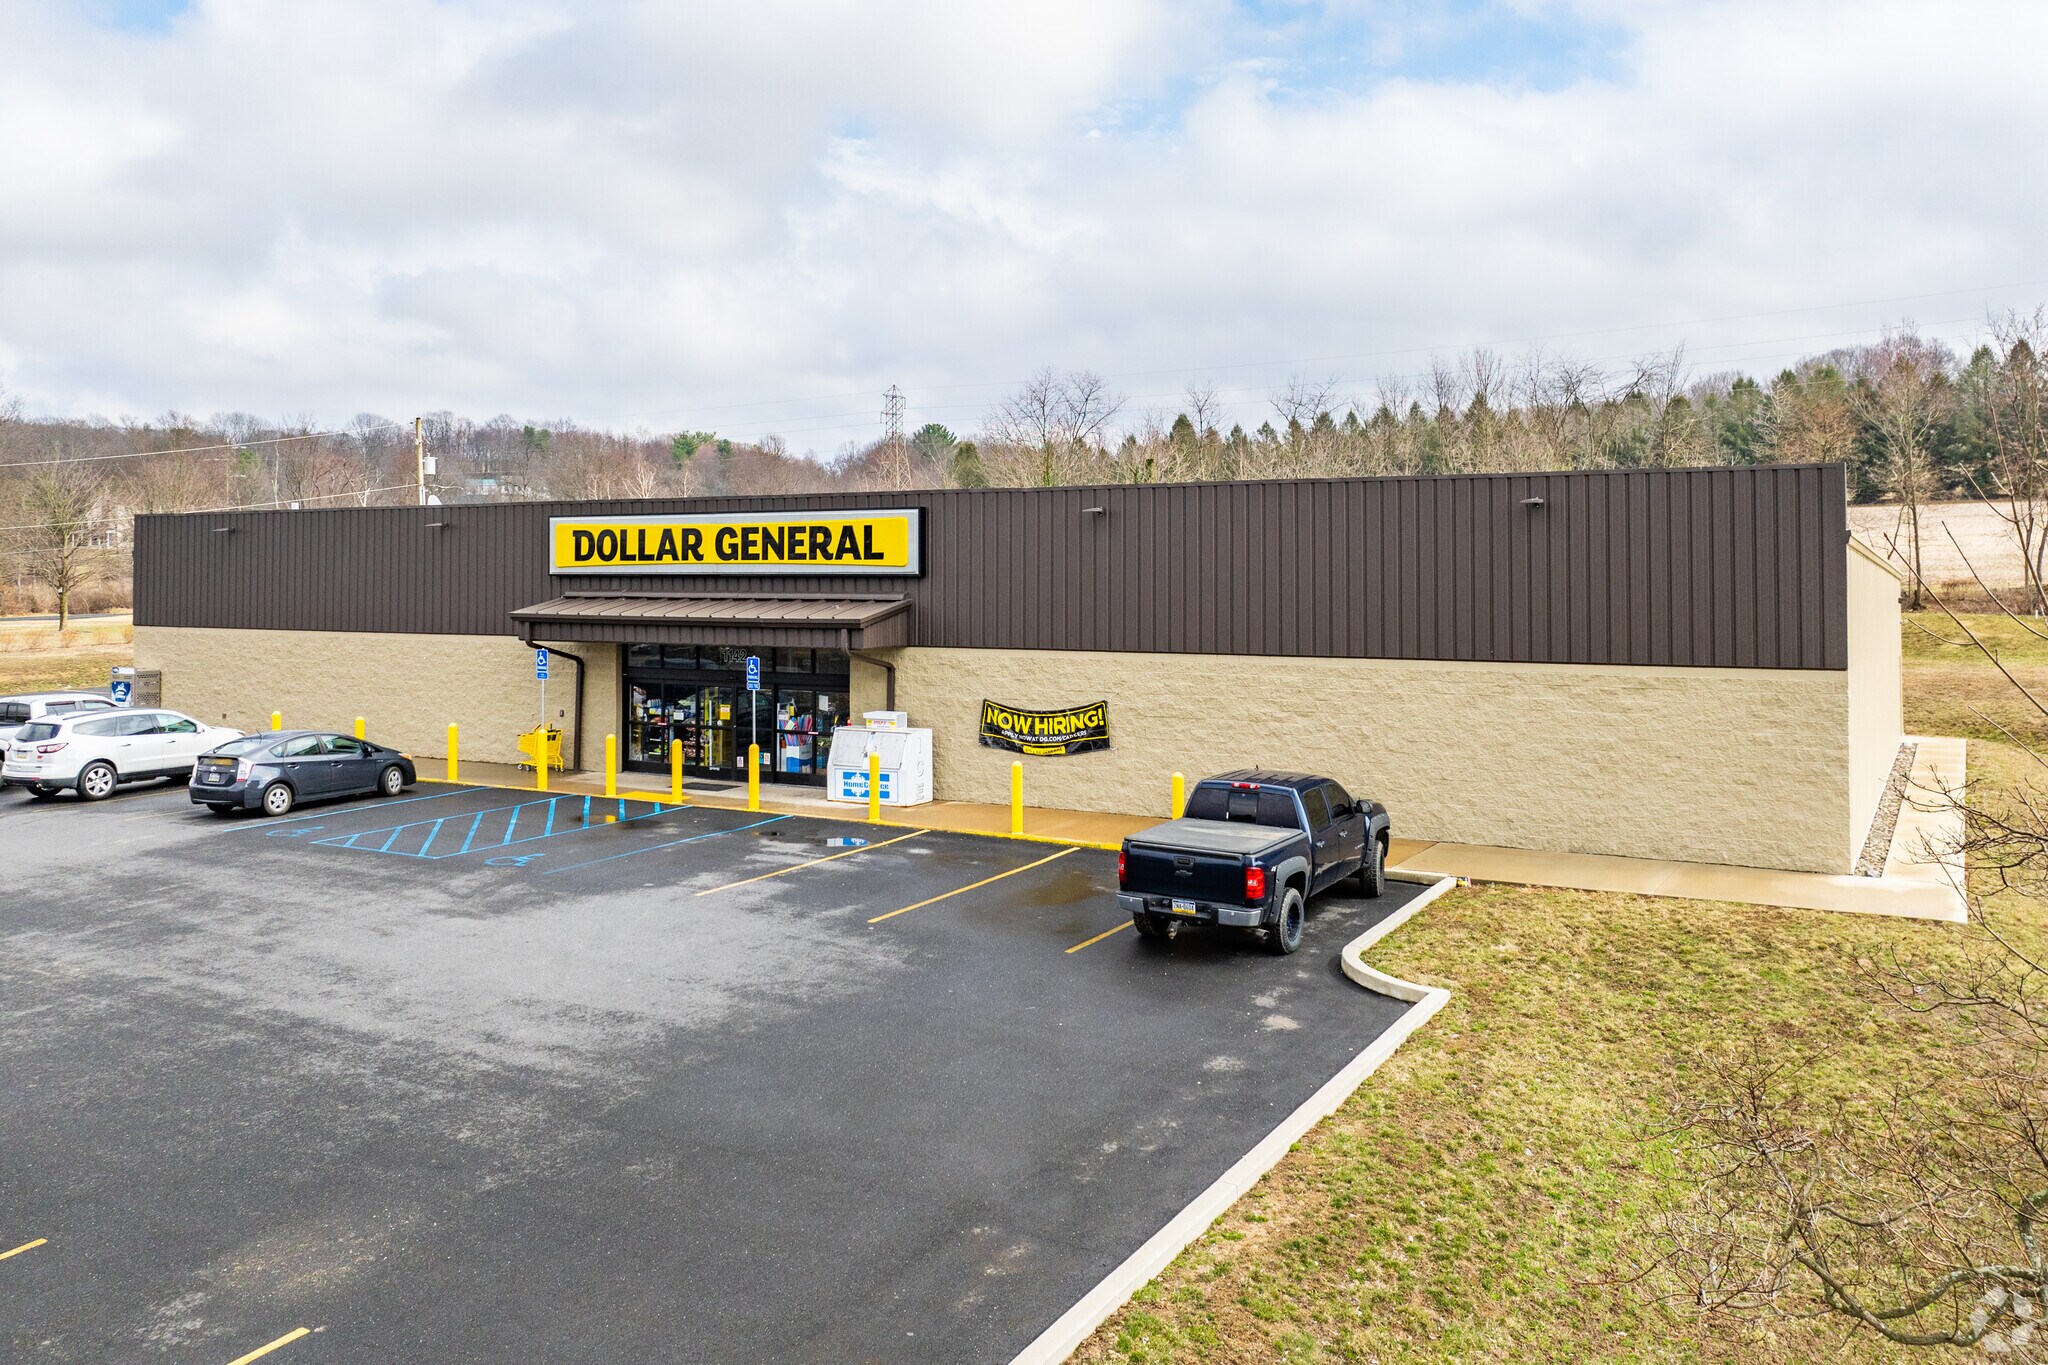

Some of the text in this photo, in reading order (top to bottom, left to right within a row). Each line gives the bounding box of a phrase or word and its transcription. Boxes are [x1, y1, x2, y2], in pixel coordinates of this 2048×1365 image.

[572, 524, 885, 562] DOLLAR GENERAL
[722, 648, 748, 663] 1142
[986, 707, 1105, 735] NOW HIRING!
[1001, 730, 1018, 740] APPLY
[1018, 734, 1032, 742] NOW
